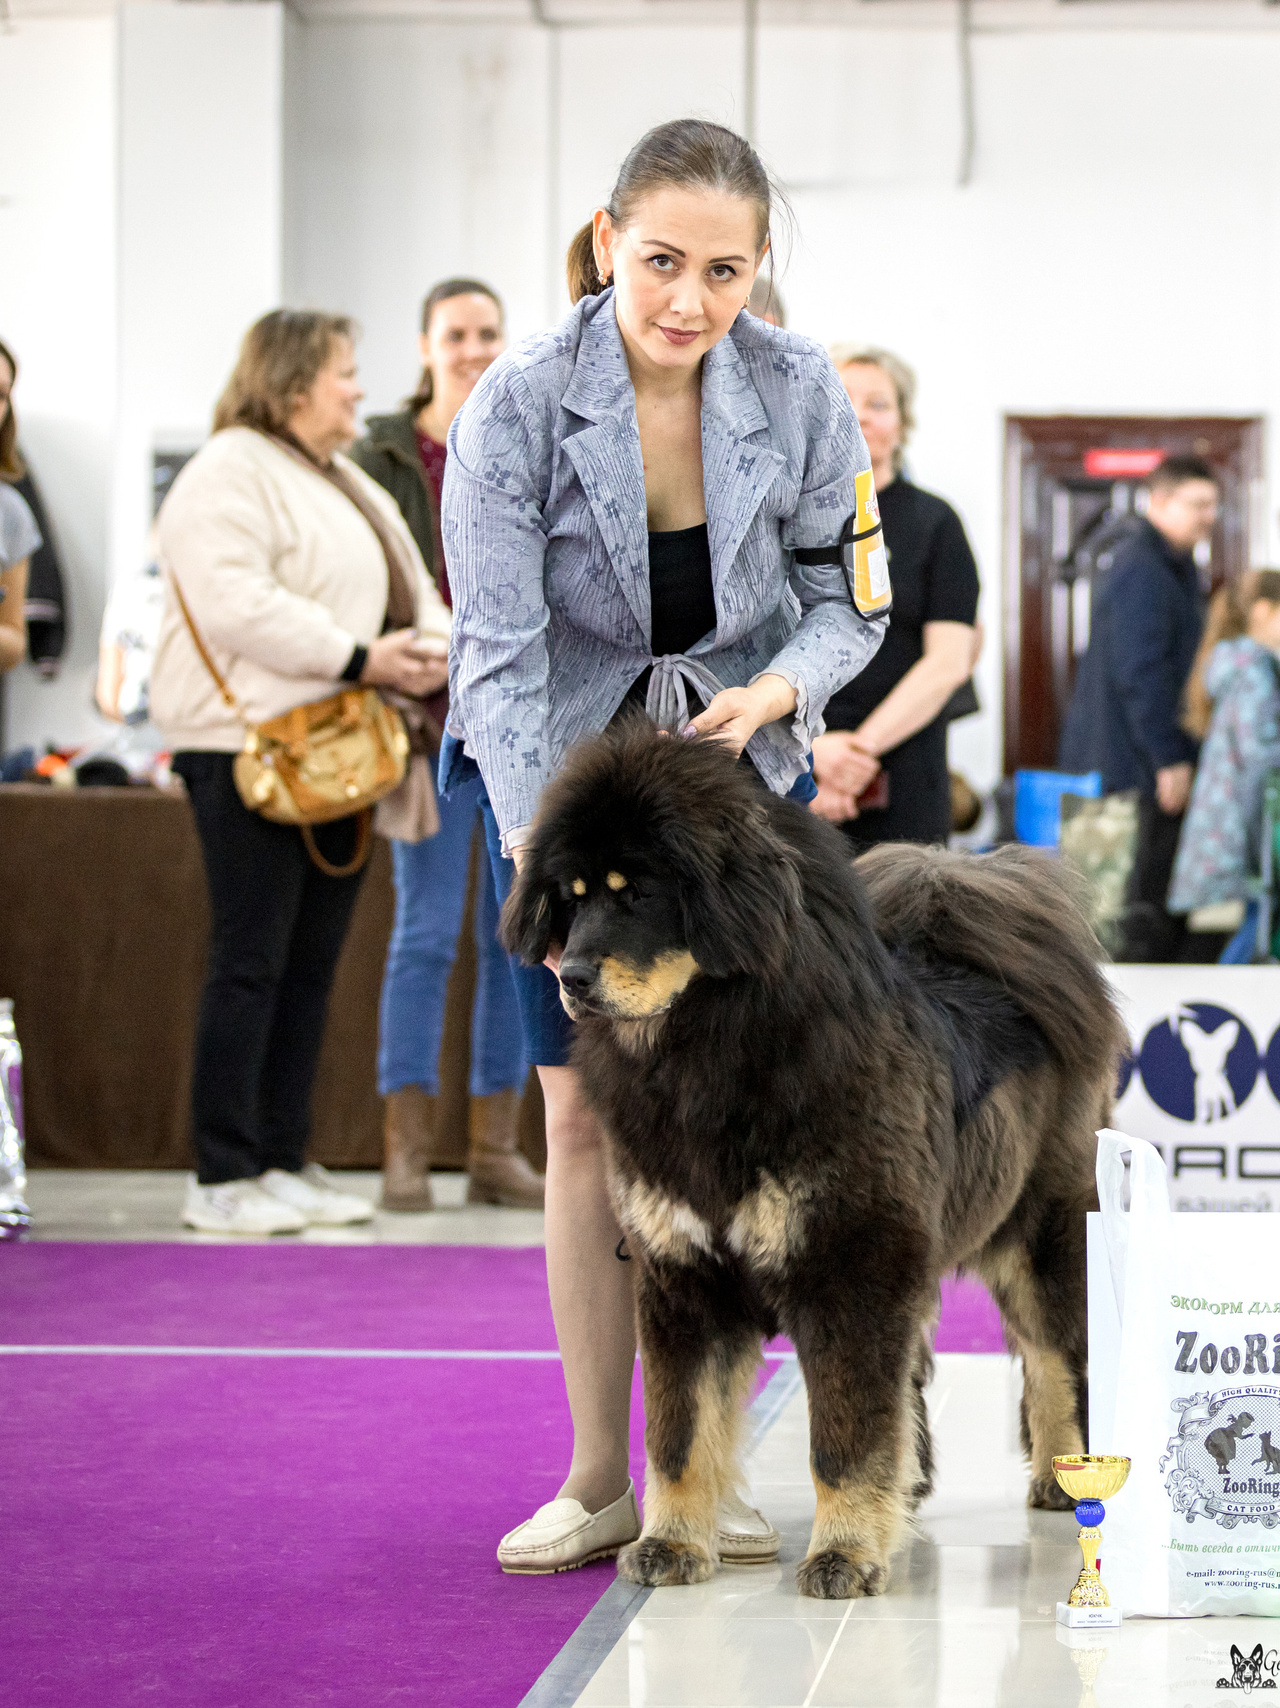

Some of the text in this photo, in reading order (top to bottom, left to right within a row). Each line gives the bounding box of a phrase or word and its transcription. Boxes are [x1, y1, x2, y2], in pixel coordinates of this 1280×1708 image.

[1222, 1388, 1243, 1397] HIGH
[1222, 1478, 1280, 1497] ZooRing
[1227, 1504, 1276, 1513] CAT FOOD
[1201, 1541, 1234, 1554] всегда
[1236, 1545, 1242, 1554] в
[1186, 1569, 1216, 1578] e-mail:
